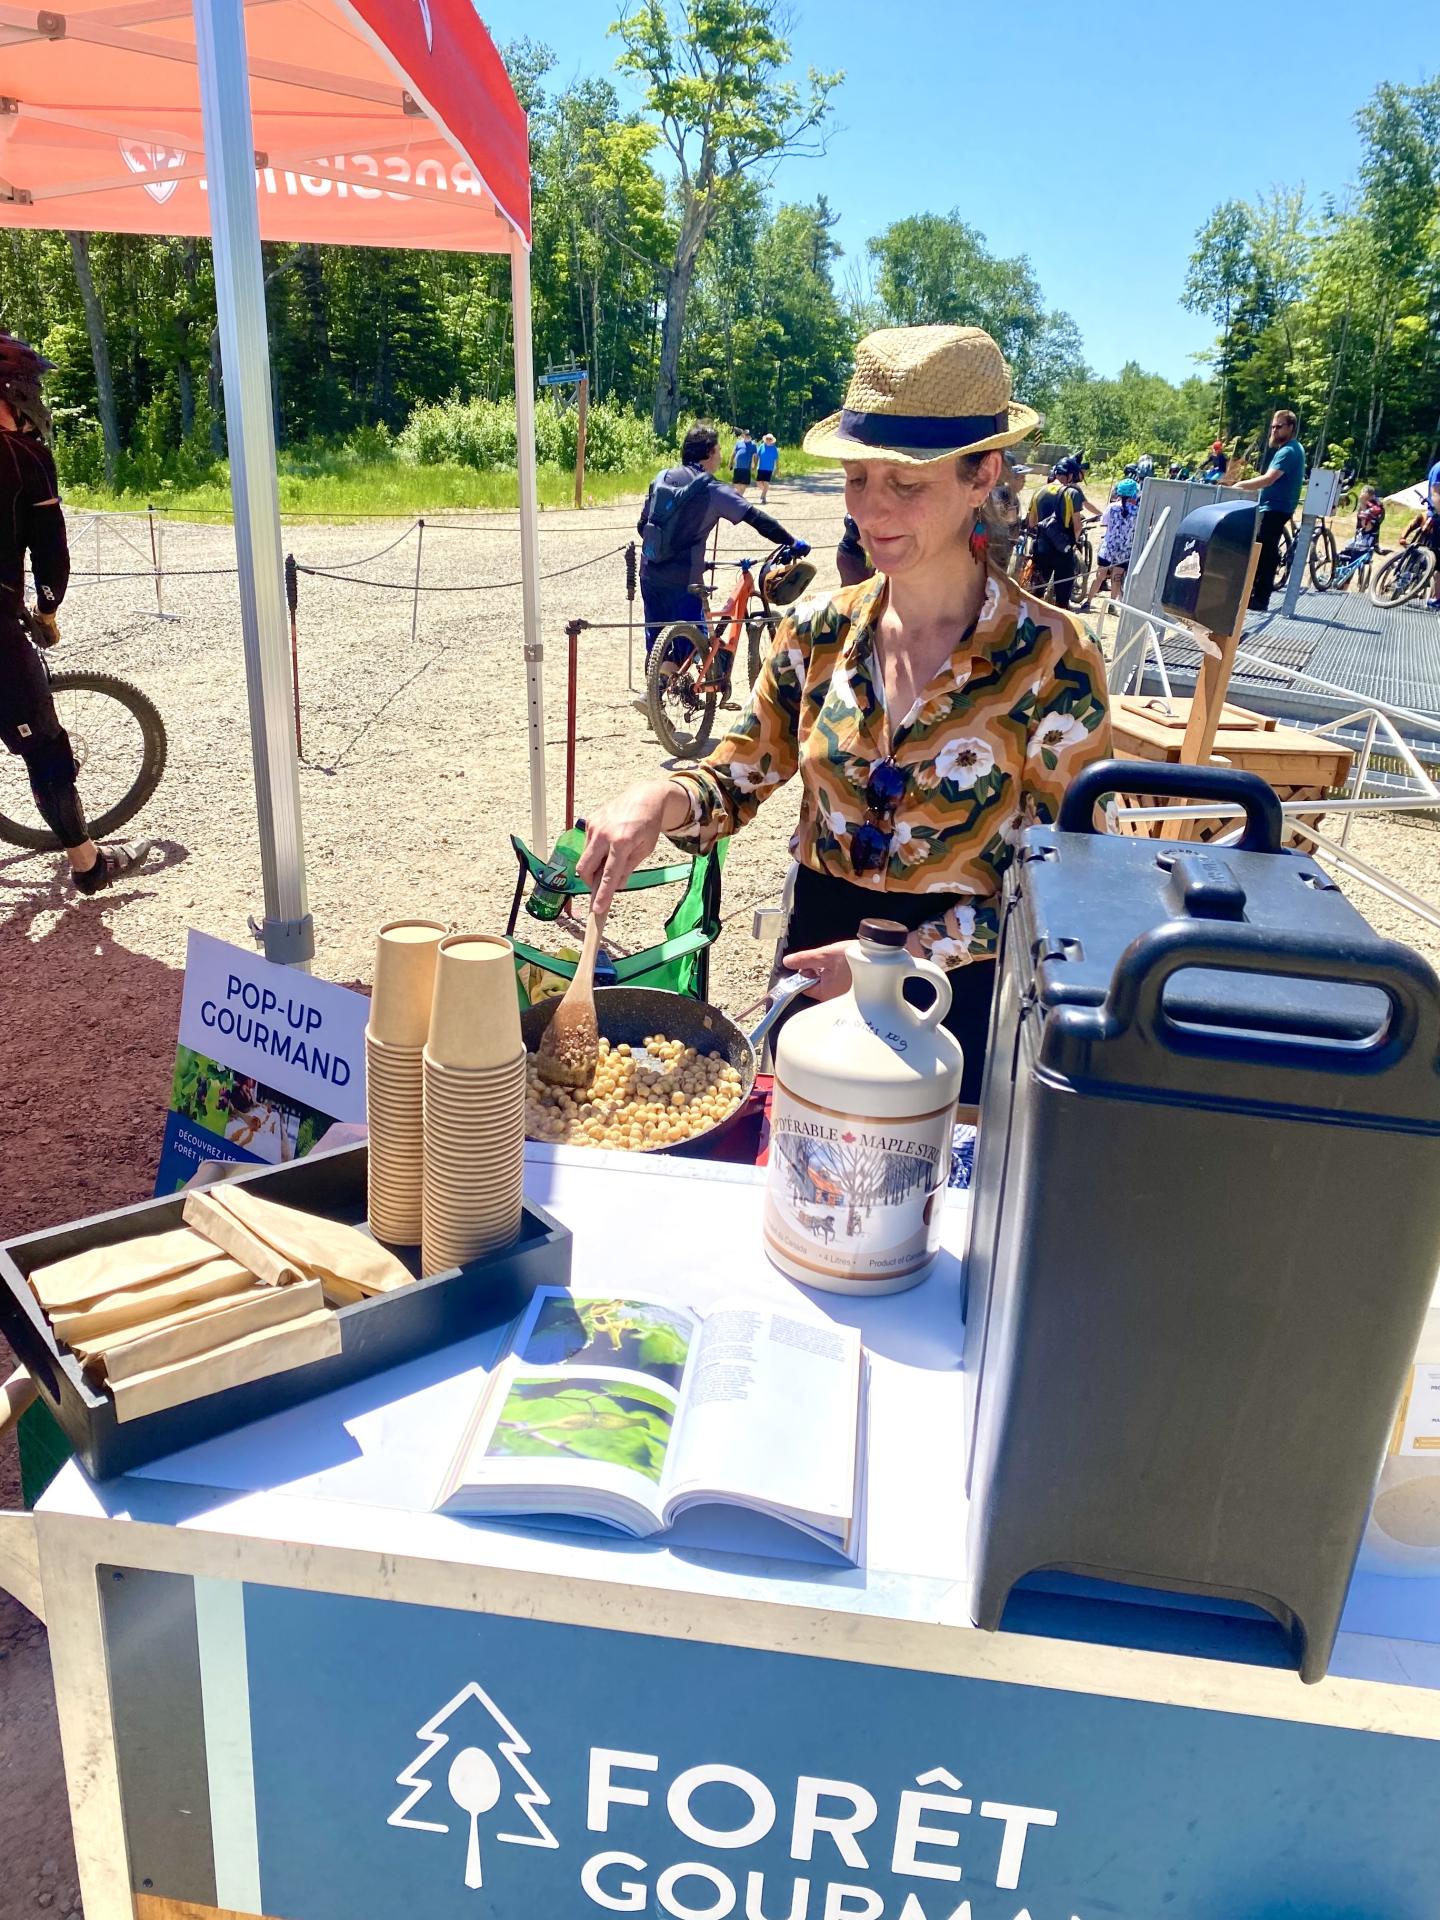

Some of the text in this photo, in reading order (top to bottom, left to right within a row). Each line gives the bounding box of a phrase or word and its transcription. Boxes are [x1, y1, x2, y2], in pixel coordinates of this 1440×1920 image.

[227, 974, 322, 1034] POP-UP
[201, 1001, 351, 1086] GOURMAND
[173, 1141, 198, 1160] FORÊT
[178, 1129, 222, 1158] DÉCOUVREZ
[859, 1133, 916, 1154] MAPLE
[586, 1746, 1059, 1890] FORÊT
